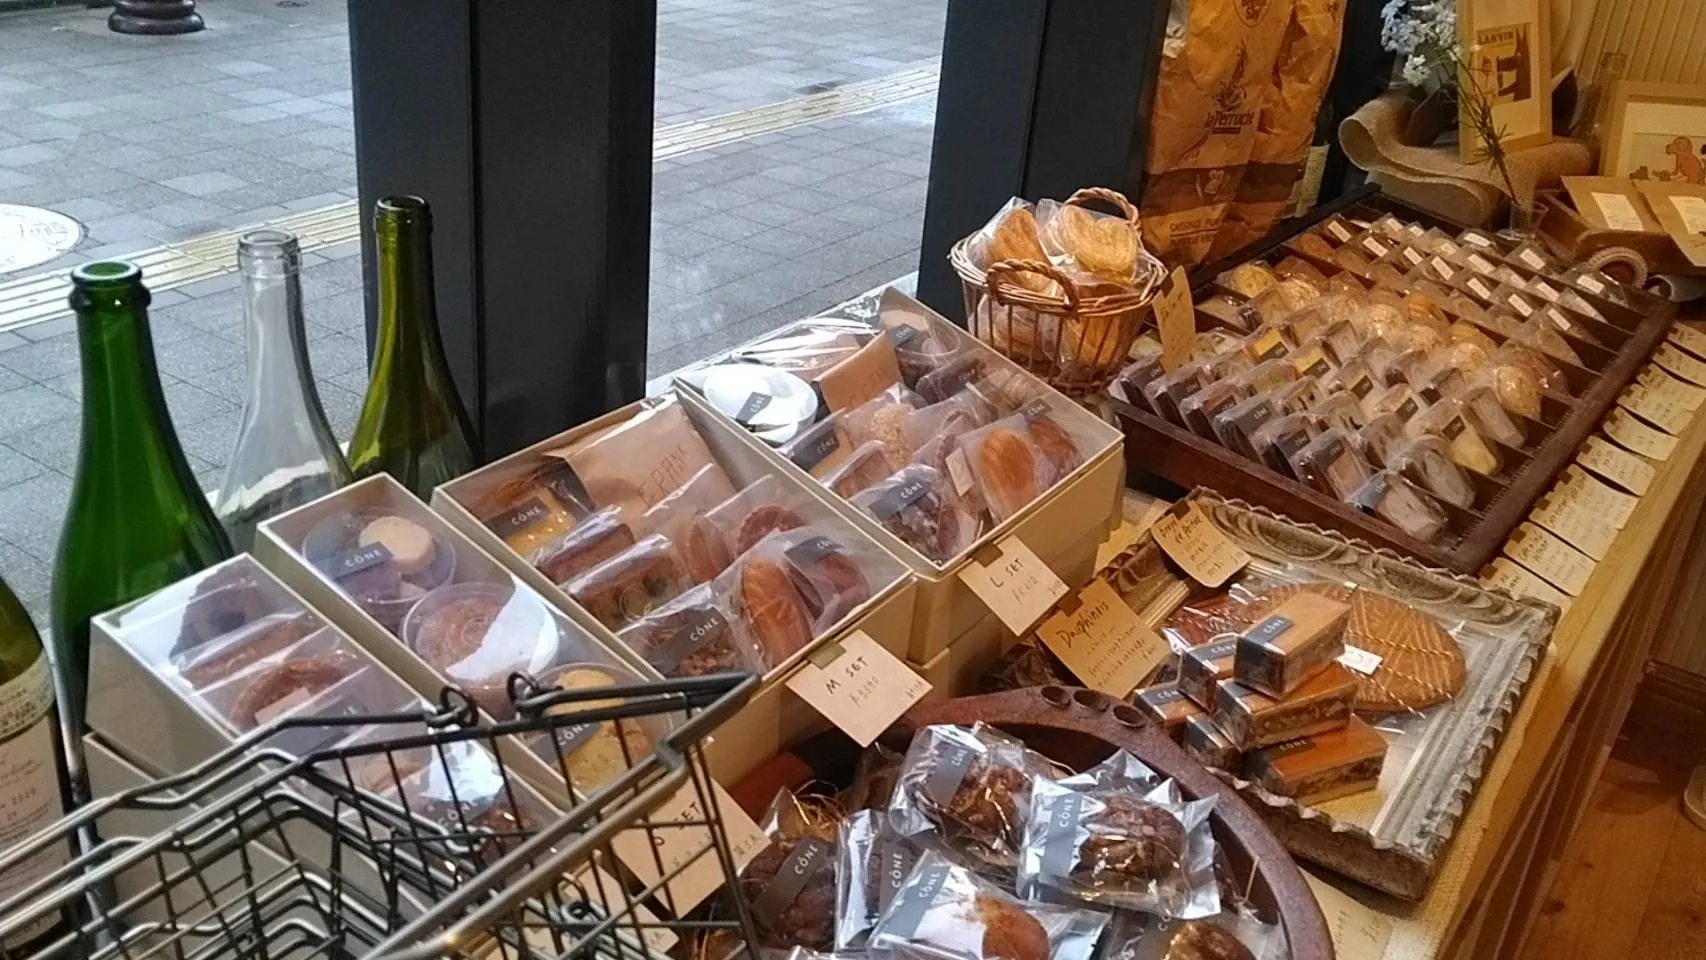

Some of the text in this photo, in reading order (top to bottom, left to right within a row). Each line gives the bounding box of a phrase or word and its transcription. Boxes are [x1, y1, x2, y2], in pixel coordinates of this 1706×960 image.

[901, 481, 923, 498] CÔNE
[510, 506, 542, 525] CÔNE
[344, 549, 382, 567] CÔNE
[989, 557, 1024, 588] L SET
[689, 615, 721, 642] CÔNE
[1263, 618, 1286, 635] CÔNE
[825, 655, 869, 695] M SET
[1156, 690, 1180, 699] CÔN
[1058, 797, 1075, 828] CÔNE
[794, 844, 818, 875] CÔNE
[890, 852, 903, 888] CÔNE
[918, 872, 941, 898] CÔNE
